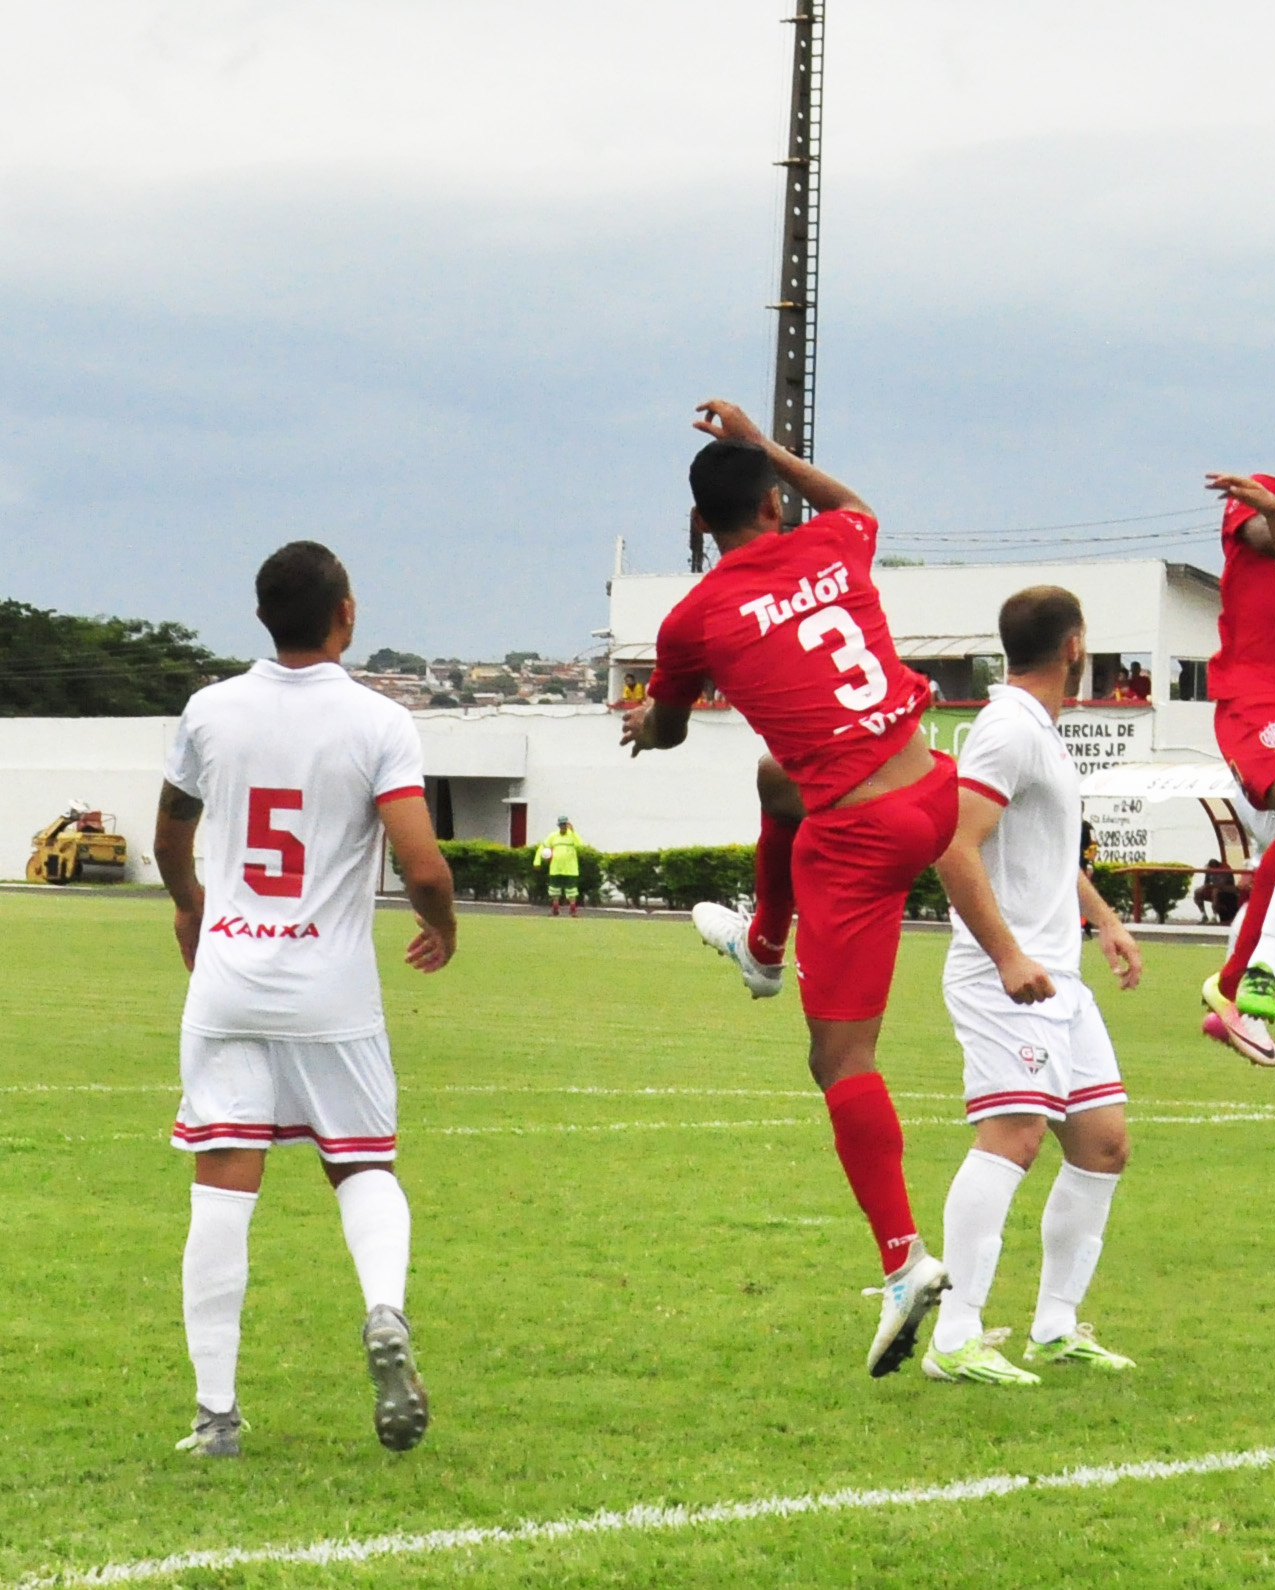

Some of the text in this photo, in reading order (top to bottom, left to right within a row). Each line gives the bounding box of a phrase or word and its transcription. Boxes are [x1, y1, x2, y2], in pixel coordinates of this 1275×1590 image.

[739, 566, 849, 637] Tudor
[797, 605, 888, 711] 3
[1117, 723, 1135, 737] DE
[243, 786, 306, 898] 5
[209, 915, 320, 939] KANXA
